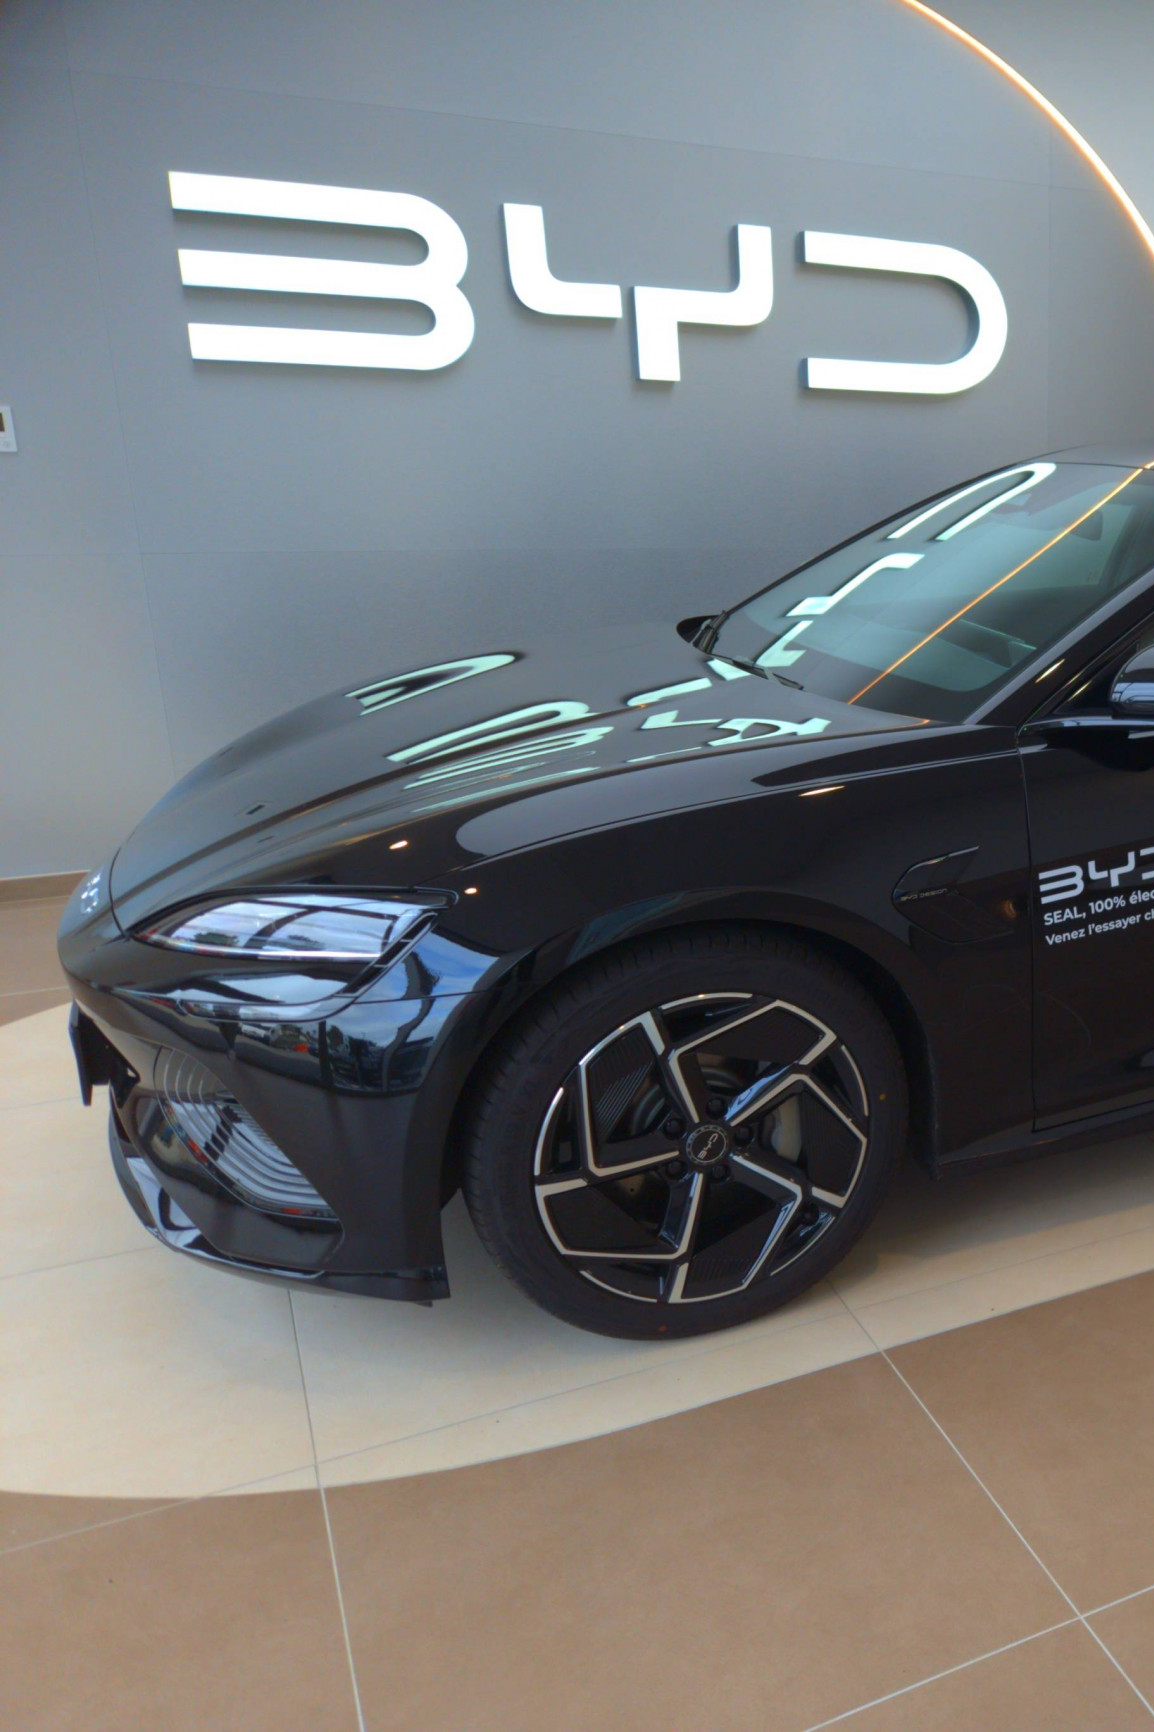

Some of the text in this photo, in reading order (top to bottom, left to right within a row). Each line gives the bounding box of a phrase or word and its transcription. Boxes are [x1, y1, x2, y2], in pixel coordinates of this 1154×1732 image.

[167, 170, 1009, 395] BYD
[1043, 906, 1087, 926] SEAL,
[1088, 895, 1126, 915] 100%
[1045, 928, 1086, 946] Venez
[1088, 913, 1142, 936] l'essayer
